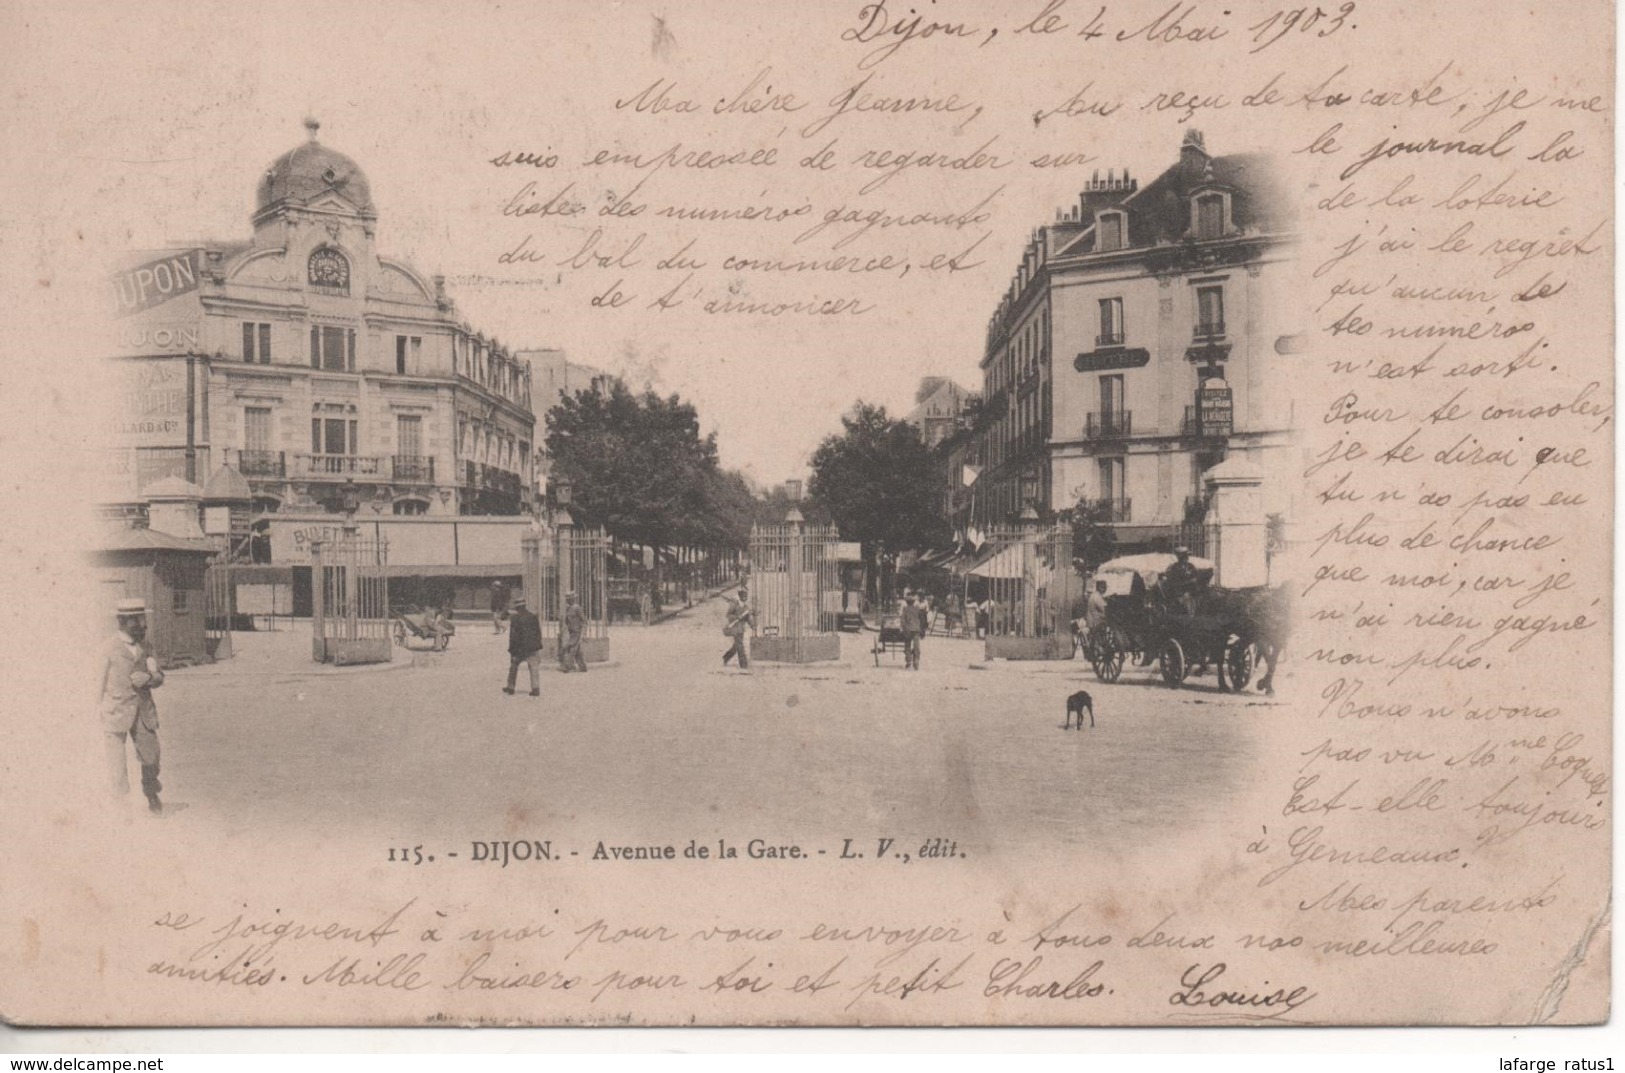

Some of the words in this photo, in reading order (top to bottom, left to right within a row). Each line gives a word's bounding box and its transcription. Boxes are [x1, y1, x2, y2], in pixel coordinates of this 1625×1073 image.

[842, 0, 999, 69] Dijon,
[1012, 0, 1063, 36] le
[1077, 4, 1106, 42] 4
[1116, 0, 1231, 43] Mai
[1247, 0, 1357, 54] 1903.
[614, 78, 702, 115] Ma
[1241, 72, 1285, 108] de
[1467, 76, 1550, 131] je
[1549, 93, 1608, 114] me
[489, 148, 560, 170] suis
[798, 140, 839, 170] de
[849, 135, 1013, 195] regarder
[1029, 153, 1100, 170] sur
[1294, 122, 1344, 155] le
[1340, 121, 1527, 181] journal
[1527, 130, 1585, 163] la
[598, 188, 639, 219] des
[653, 190, 812, 222] numéros
[794, 183, 1008, 244] gagnants
[1317, 182, 1368, 212] de
[1367, 174, 1425, 208] la
[1431, 169, 1567, 211] loterie
[497, 232, 546, 268] du
[561, 229, 642, 271] bal
[654, 233, 710, 271] du
[721, 253, 913, 281] commerce,
[918, 229, 994, 273] et
[1427, 220, 1475, 253] le
[590, 279, 634, 309] de
[1322, 303, 1374, 337] tes
[1380, 306, 1536, 340] numéros
[1324, 392, 1411, 425] Pour
[1422, 387, 1472, 425] te
[1302, 430, 1369, 478] je
[1374, 428, 1425, 466] te
[1518, 446, 1593, 485] que
[1317, 471, 1365, 505] tu
[1452, 489, 1531, 526] pas
[1540, 490, 1590, 507] eu
[1310, 512, 1390, 558] plus
[1399, 520, 1443, 551] de
[1449, 517, 1565, 552] chance
[1301, 563, 1369, 598] que
[1383, 561, 1466, 598] moi,
[1472, 576, 1525, 592] car
[1512, 557, 1576, 610] je
[1403, 604, 1482, 630] rien
[1465, 597, 1602, 654] gagné
[1305, 647, 1385, 666] non
[1387, 634, 1492, 685] plus.
[1317, 677, 1414, 720] Nous
[1297, 736, 1371, 774] pas
[1381, 750, 1439, 766] vu
[1463, 775, 1607, 831] toujours
[387, 844, 434, 865] 115.
[471, 840, 561, 866] DIJON.
[592, 840, 675, 860] Avenue
[684, 839, 709, 860] de
[719, 838, 737, 859] la
[747, 838, 807, 859] Gare.
[839, 838, 863, 859] L.
[918, 837, 967, 859] édit.
[1246, 824, 1270, 854] à
[1298, 881, 1389, 913] Mes
[1386, 873, 1566, 932] parents
[153, 908, 201, 931] se
[188, 896, 416, 962] joignent
[419, 910, 447, 944] à
[458, 908, 561, 944] moi
[565, 917, 681, 959] pour
[696, 924, 785, 943] vous
[797, 922, 976, 968] envoyer
[986, 911, 1010, 944] à
[1020, 904, 1113, 950] tous
[1125, 912, 1218, 950] deux
[1236, 931, 1306, 950] nos
[1311, 920, 1500, 958] meilleures
[301, 952, 435, 991] Mille
[441, 952, 581, 993] baisers
[592, 962, 688, 1003] pour
[699, 954, 773, 994] toi
[782, 962, 841, 996] et
[844, 955, 968, 1011] petit
[982, 954, 1114, 1001] Charles.
[1168, 963, 1319, 1012] Louise
